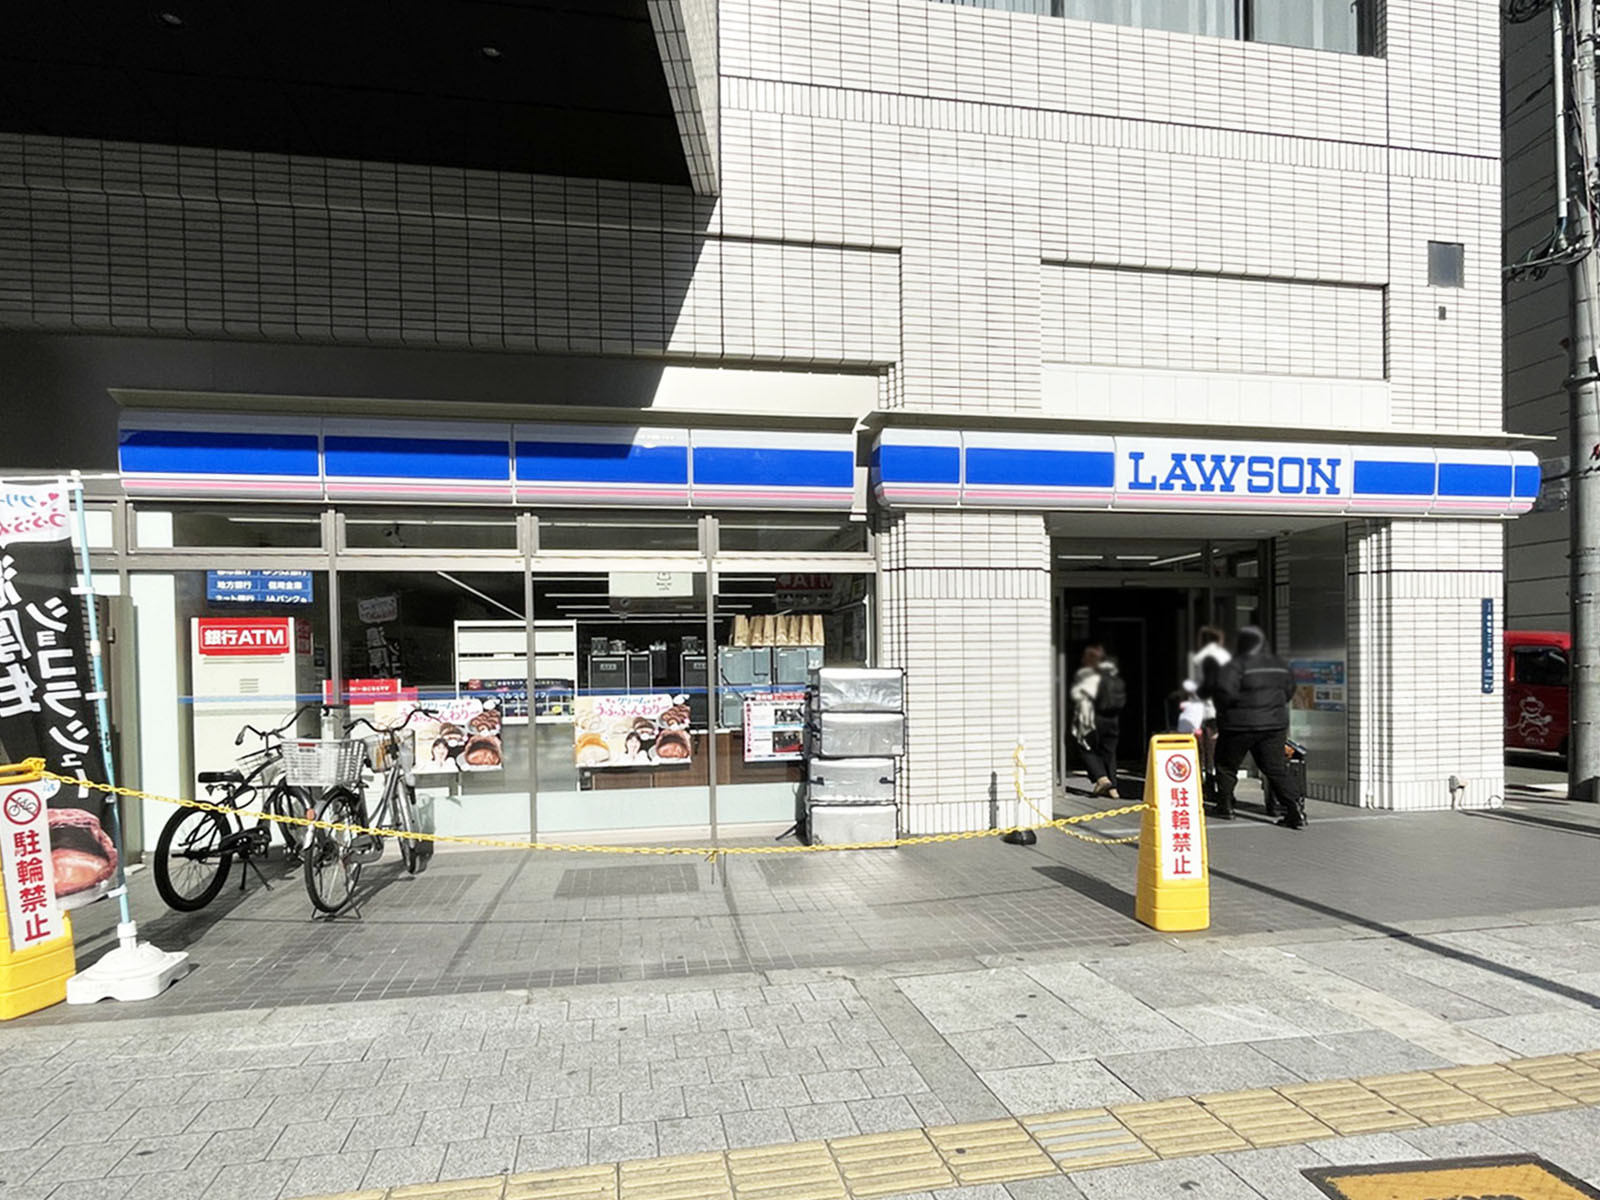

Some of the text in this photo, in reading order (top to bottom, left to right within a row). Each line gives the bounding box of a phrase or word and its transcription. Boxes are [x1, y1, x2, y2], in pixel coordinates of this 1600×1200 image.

[1128, 451, 1342, 495] LAWSON
[204, 629, 285, 646] 銀行ATM
[1170, 787, 1192, 875] 駐輪禁止
[13, 829, 51, 942] 駐輪禁止
